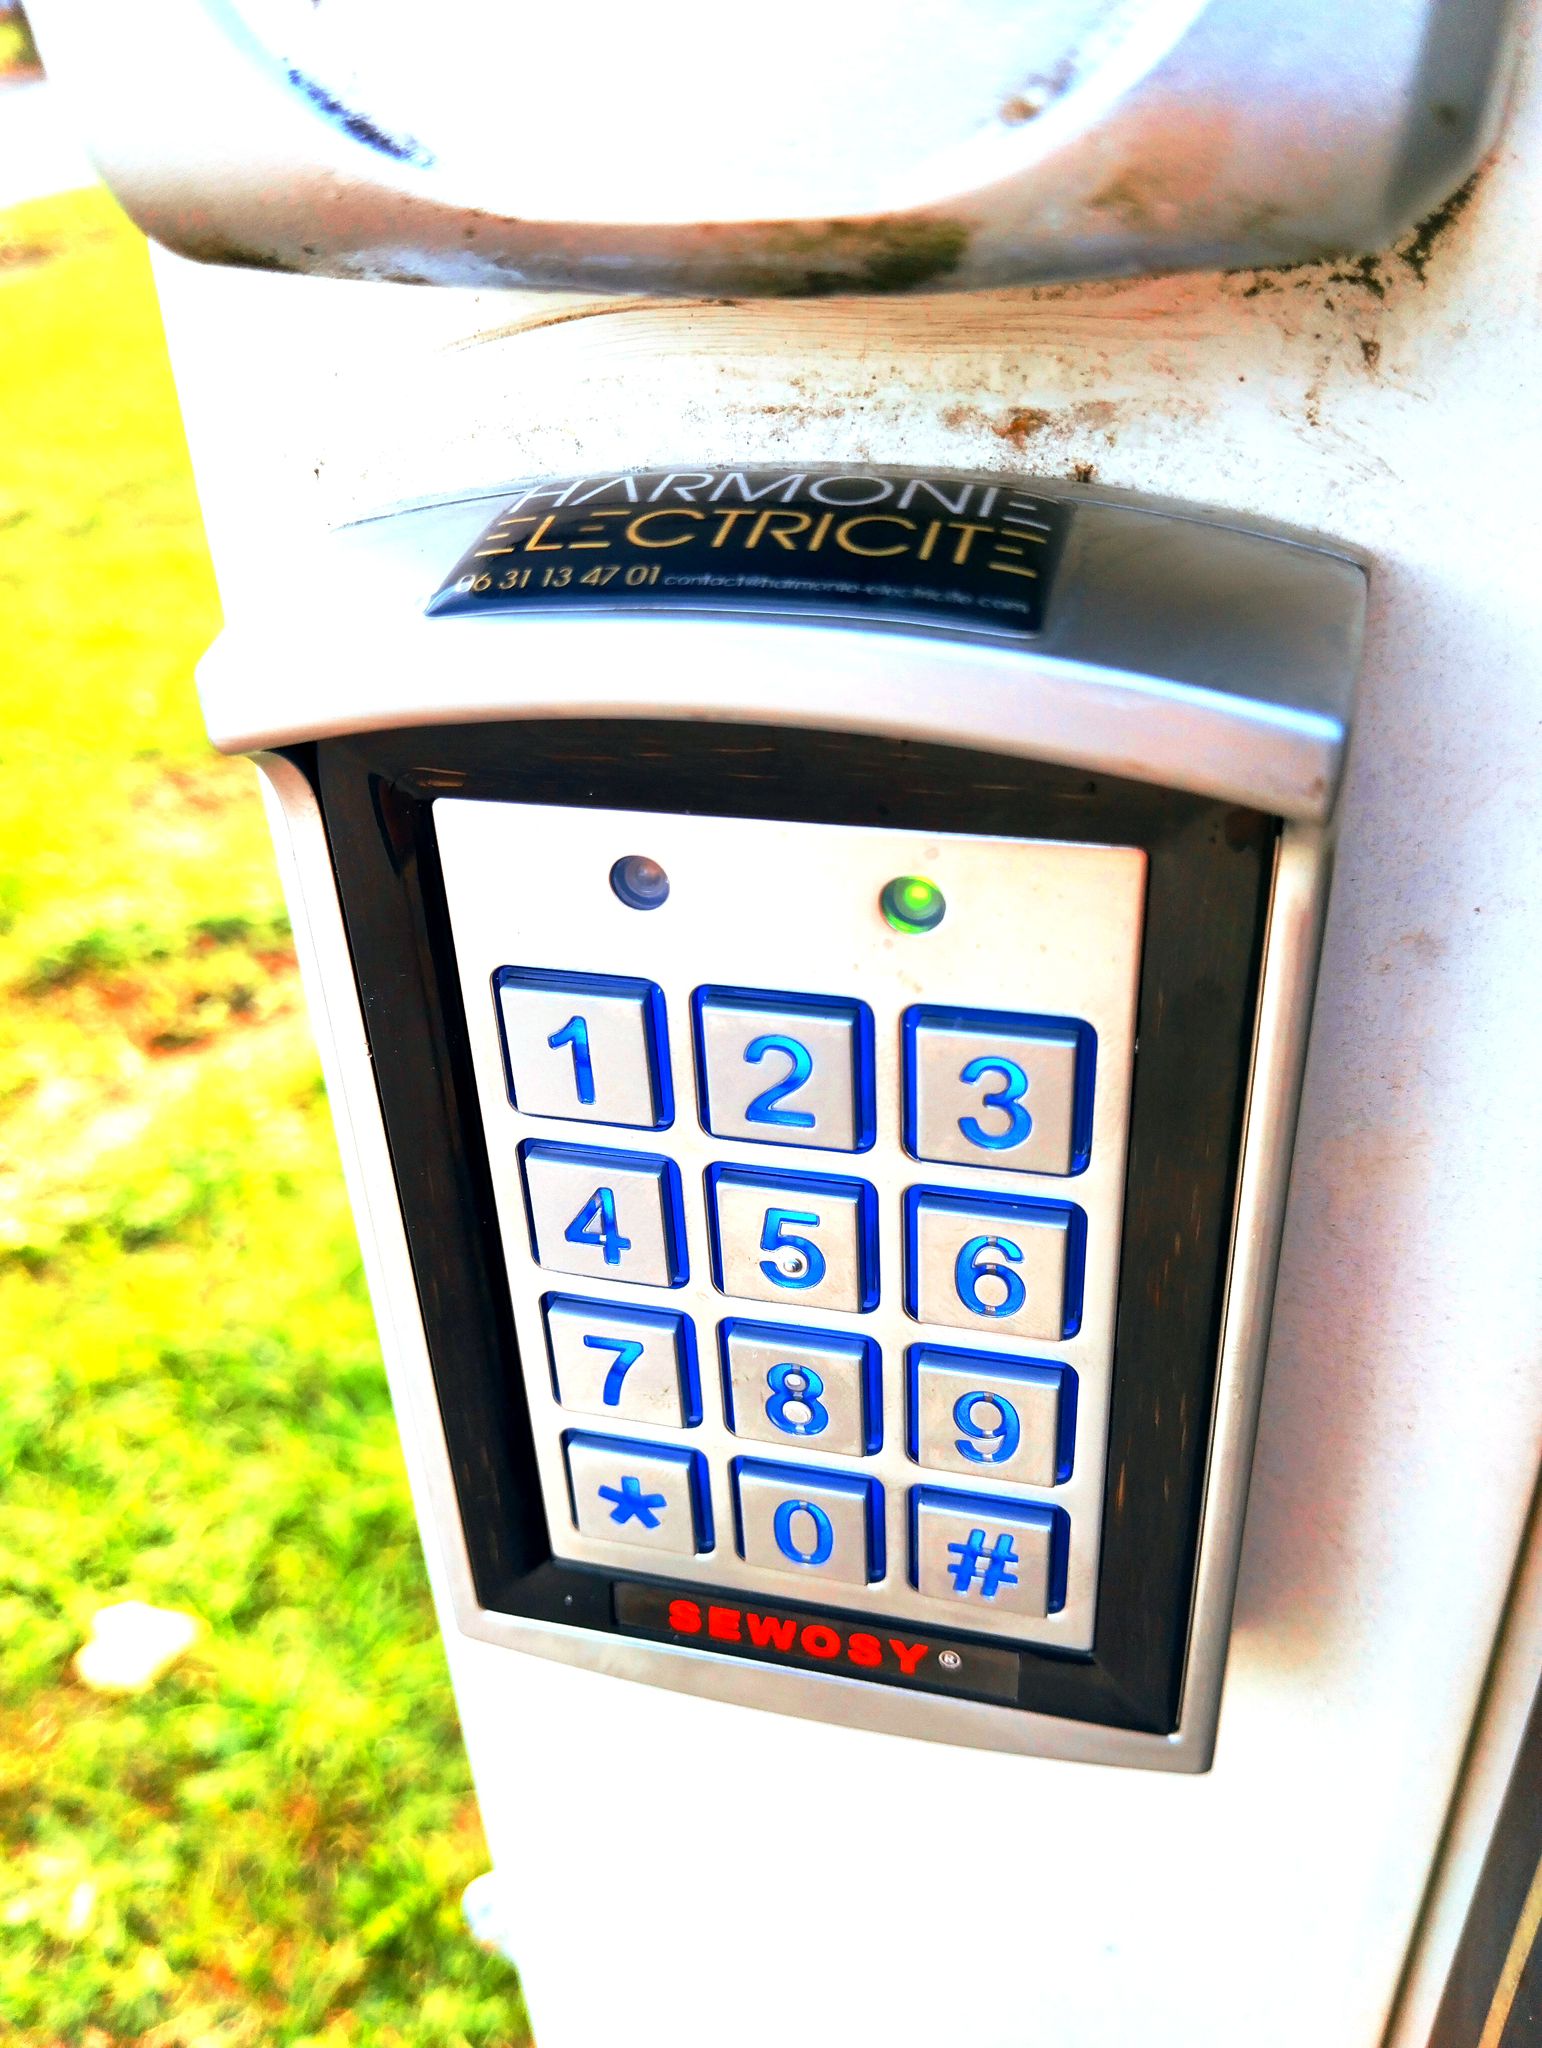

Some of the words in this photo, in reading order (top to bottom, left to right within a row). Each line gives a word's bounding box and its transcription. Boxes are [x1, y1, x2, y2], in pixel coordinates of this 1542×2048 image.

[507, 472, 1059, 532] HARMONIE
[456, 573, 492, 593] 06
[499, 568, 532, 590] 31
[542, 566, 573, 588] 13
[580, 565, 621, 587] 47
[625, 564, 661, 586] 01
[474, 508, 1048, 579] ELECTRICITE
[548, 1015, 597, 1105] 1
[744, 1034, 816, 1128] 2
[957, 1056, 1033, 1151] 3
[565, 1187, 631, 1265] 4
[759, 1207, 827, 1290] 5
[955, 1235, 1026, 1317] 6
[583, 1335, 645, 1407] 7
[764, 1362, 830, 1436] 8
[953, 1390, 1021, 1465] 9
[773, 1499, 834, 1565] 0
[667, 1599, 929, 1675] SEWOSY
